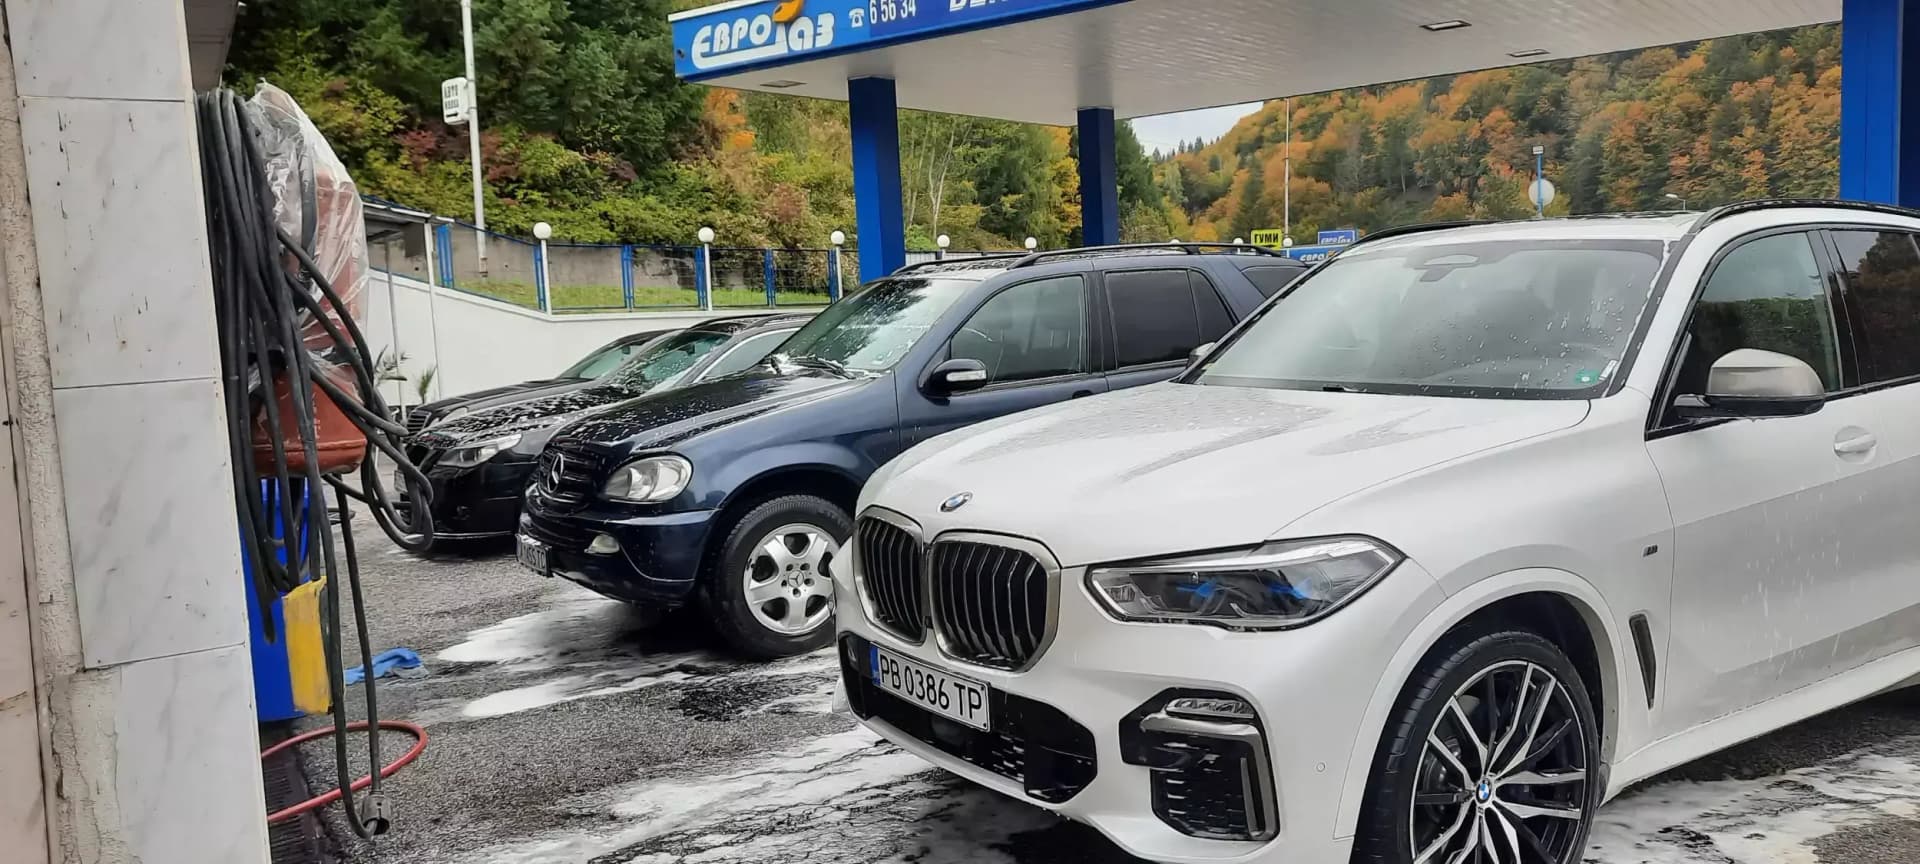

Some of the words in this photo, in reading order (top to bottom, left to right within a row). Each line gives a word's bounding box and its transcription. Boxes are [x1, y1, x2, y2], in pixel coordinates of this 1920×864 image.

[870, 0, 879, 24] 6
[881, 0, 897, 22] 56
[1255, 233, 1279, 243] ГУМИ
[880, 654, 901, 690] PB
[905, 665, 950, 710] 0386
[954, 682, 982, 719] TP
